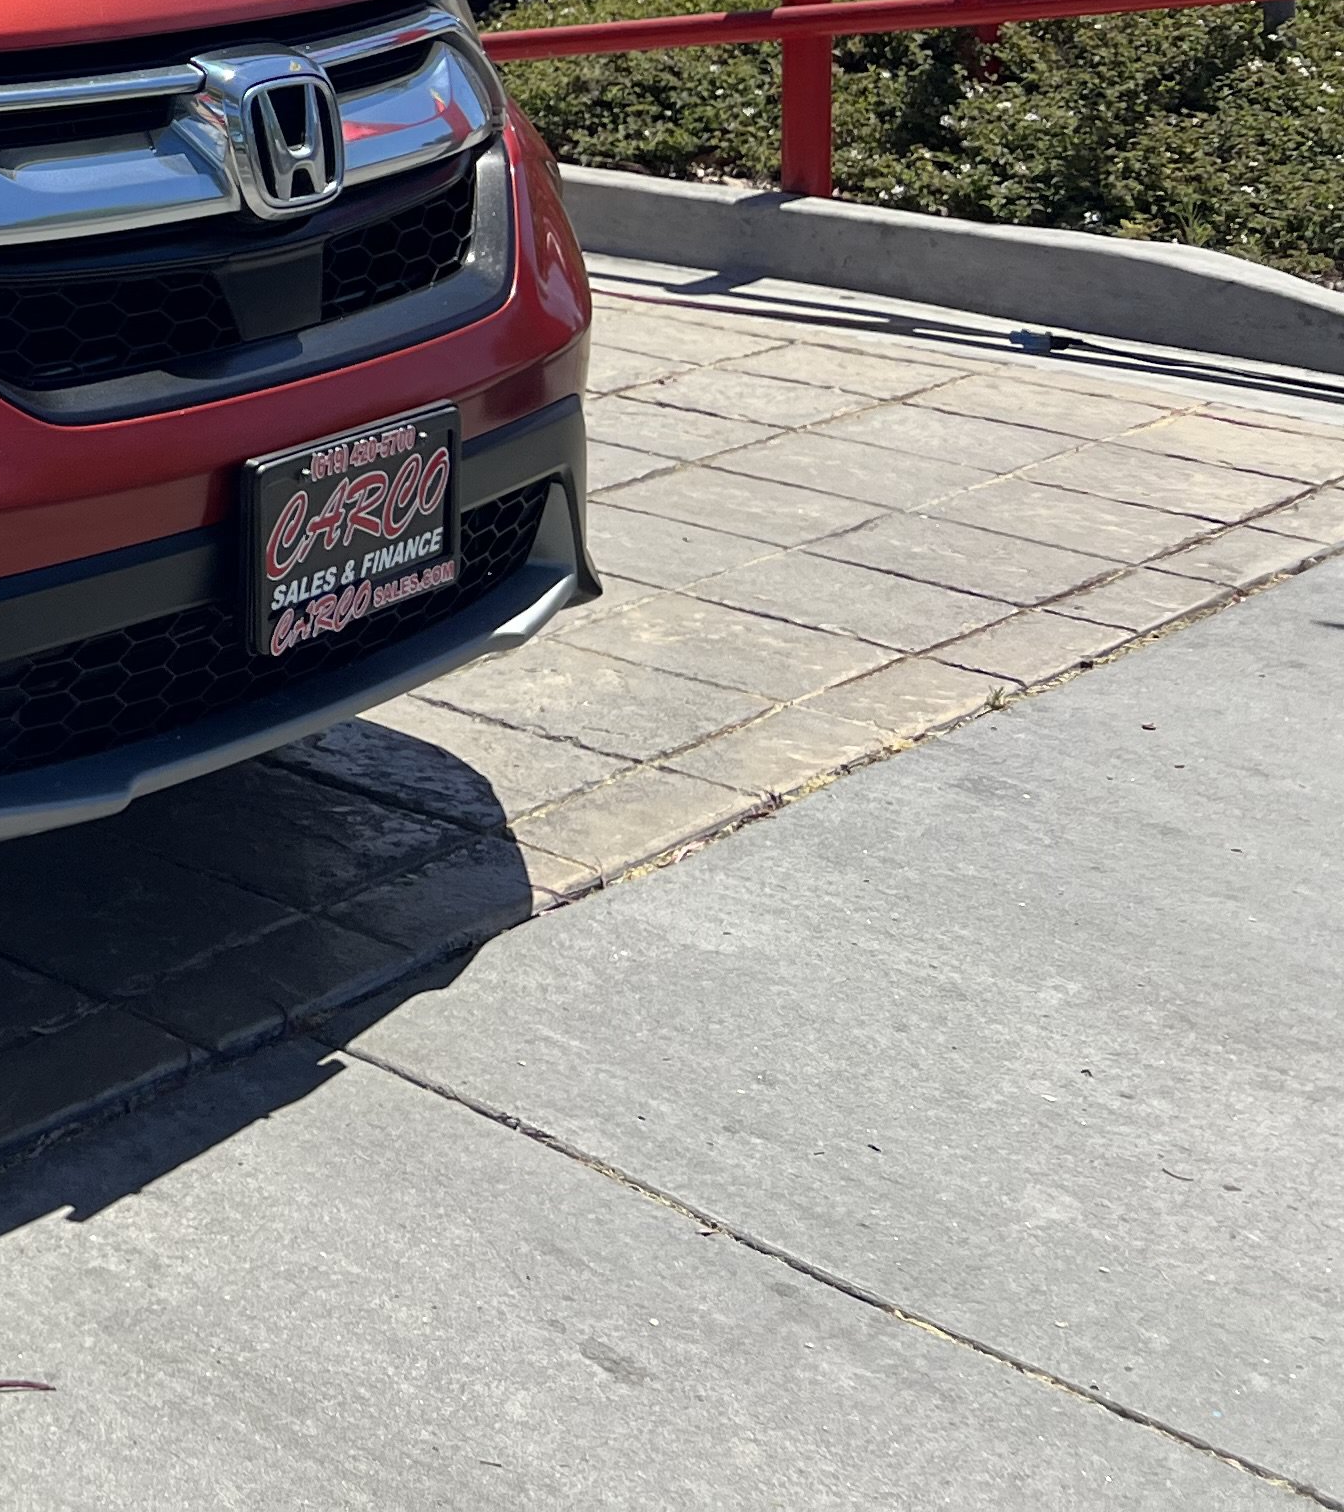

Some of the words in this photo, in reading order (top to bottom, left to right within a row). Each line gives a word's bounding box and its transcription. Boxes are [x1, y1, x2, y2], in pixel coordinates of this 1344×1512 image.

[311, 444, 348, 482] (619)
[350, 424, 416, 467] 420-5700
[265, 446, 450, 581] CARCO
[271, 579, 372, 657] CARCO
[374, 559, 455, 607] SALES.COM
[272, 568, 335, 611] SALES
[343, 560, 355, 581] &
[360, 527, 444, 578] FINANCE
